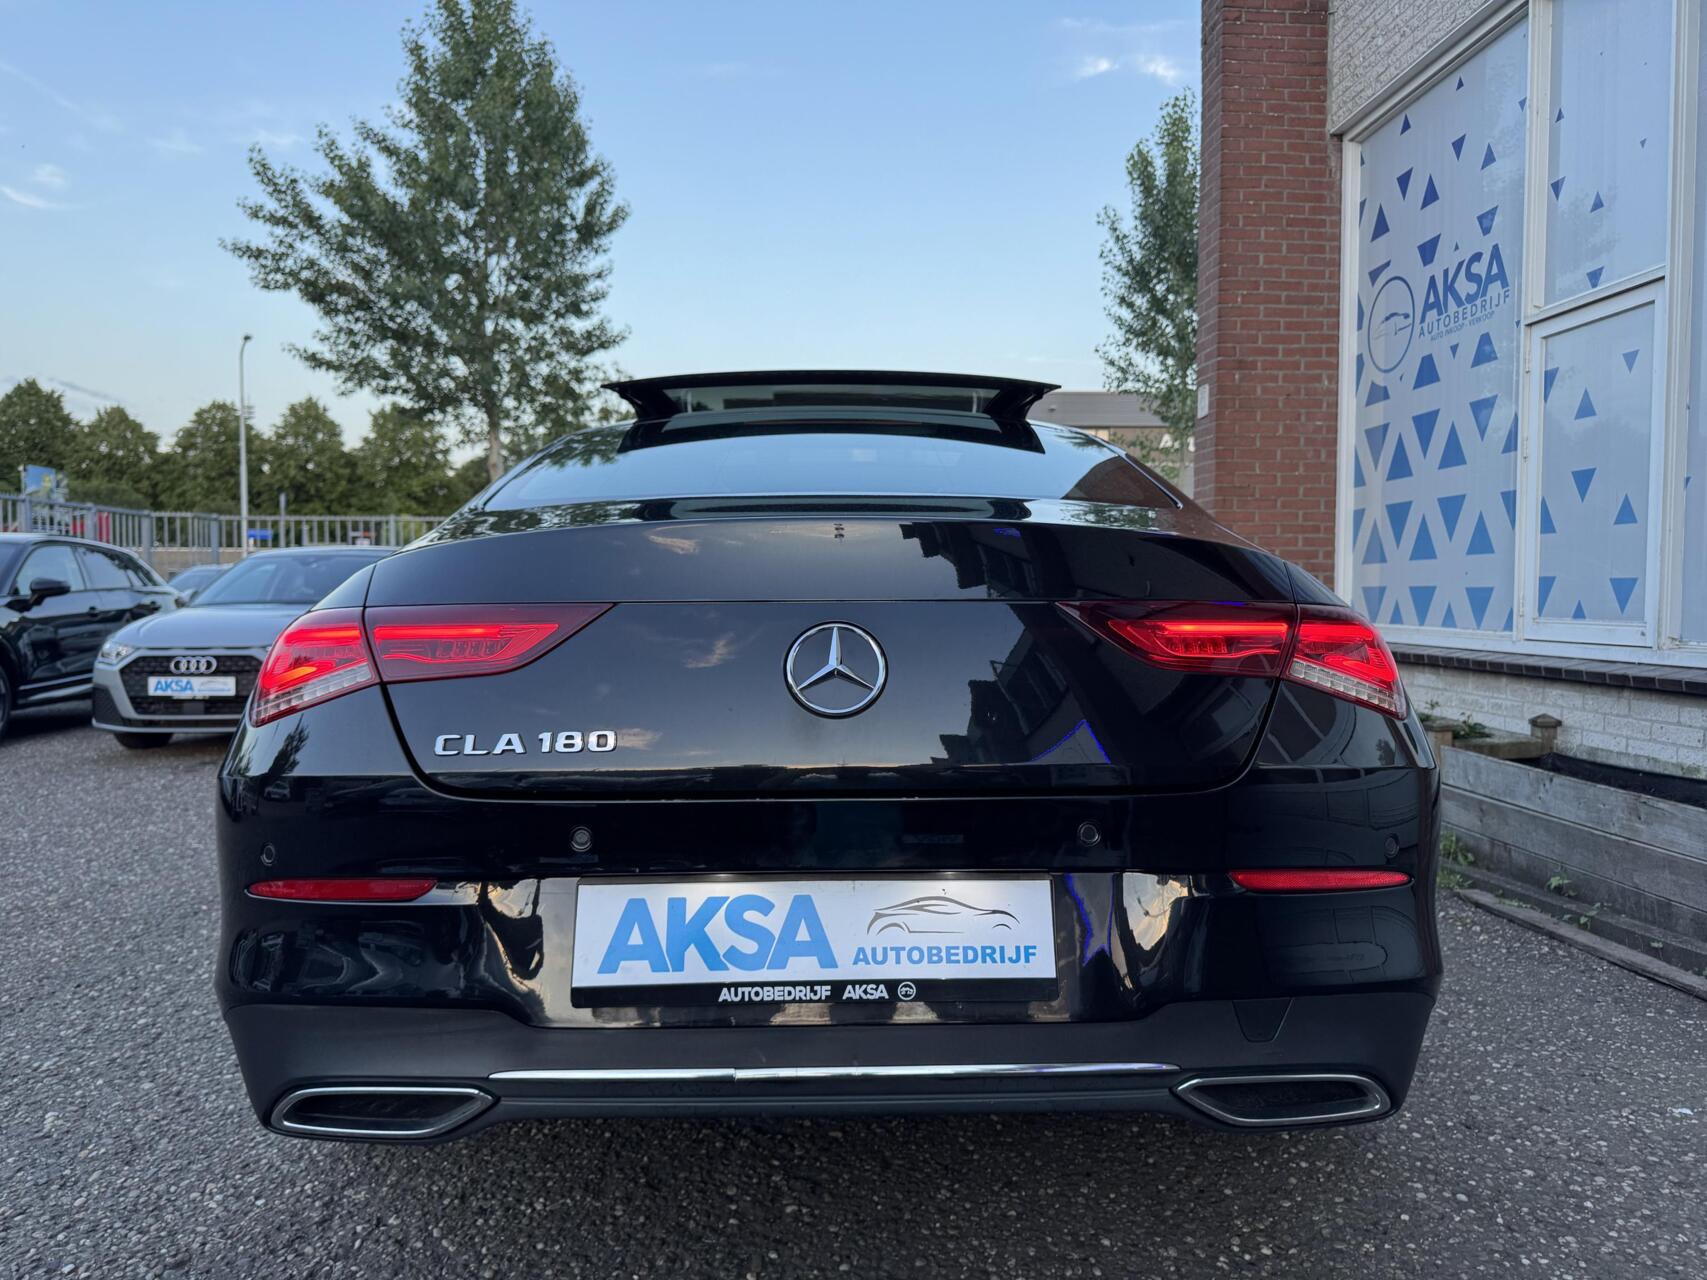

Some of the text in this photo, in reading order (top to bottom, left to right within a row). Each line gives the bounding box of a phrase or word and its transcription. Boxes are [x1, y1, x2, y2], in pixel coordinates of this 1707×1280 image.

[1420, 243, 1509, 325] AKSA
[1419, 289, 1510, 338] AUTOBEDRIJF
[154, 680, 194, 692] AKSA
[434, 731, 617, 756] CLA 180
[597, 894, 838, 974] AKSA
[852, 945, 1037, 966] AUTOBEDRIJF
[718, 984, 889, 1002] AUTOBEDRIJF AKSA
